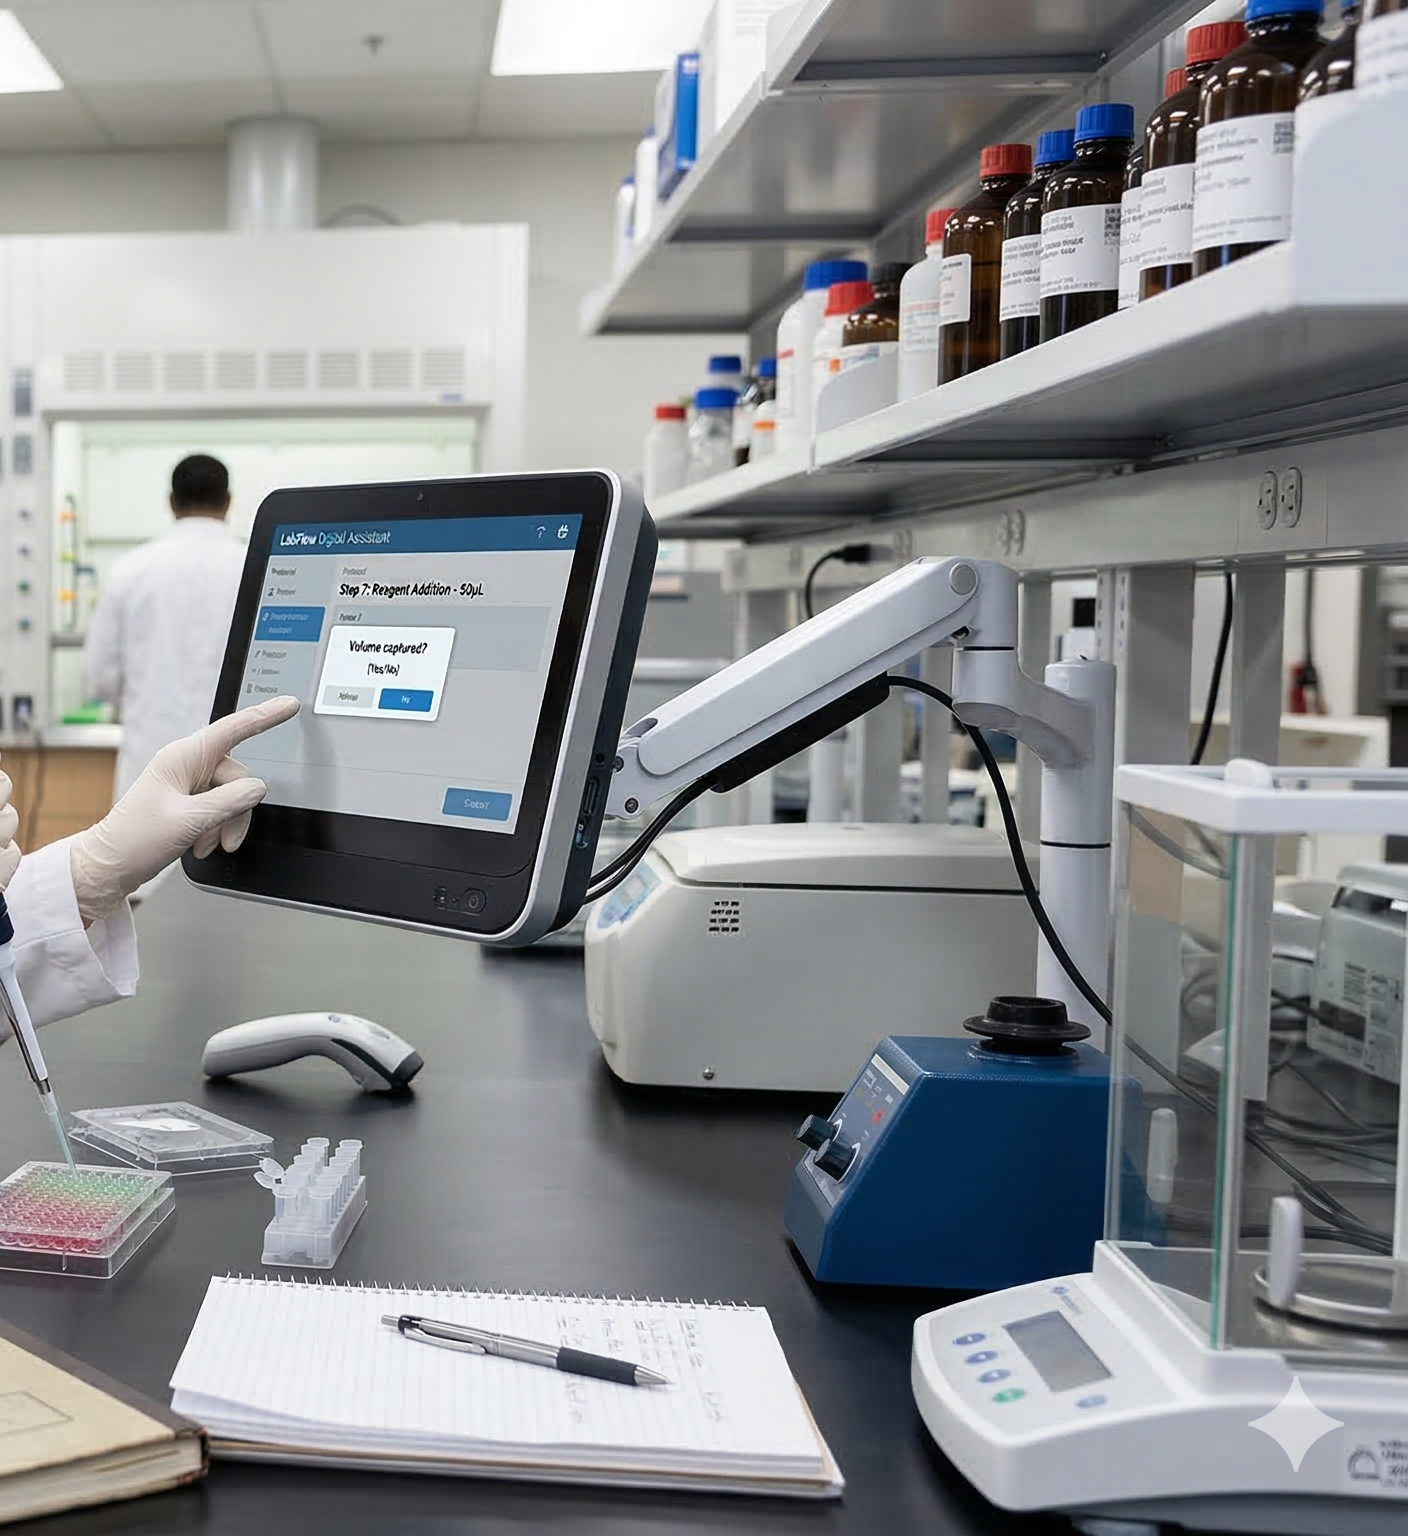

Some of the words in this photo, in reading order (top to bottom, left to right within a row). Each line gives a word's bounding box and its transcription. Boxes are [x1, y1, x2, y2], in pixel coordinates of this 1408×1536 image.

[339, 583, 360, 598] Step
[361, 583, 371, 596] 7:
[371, 583, 410, 598] Reagent
[410, 582, 451, 597] Addition
[349, 640, 381, 653] Volume
[383, 642, 428, 656] captured?
